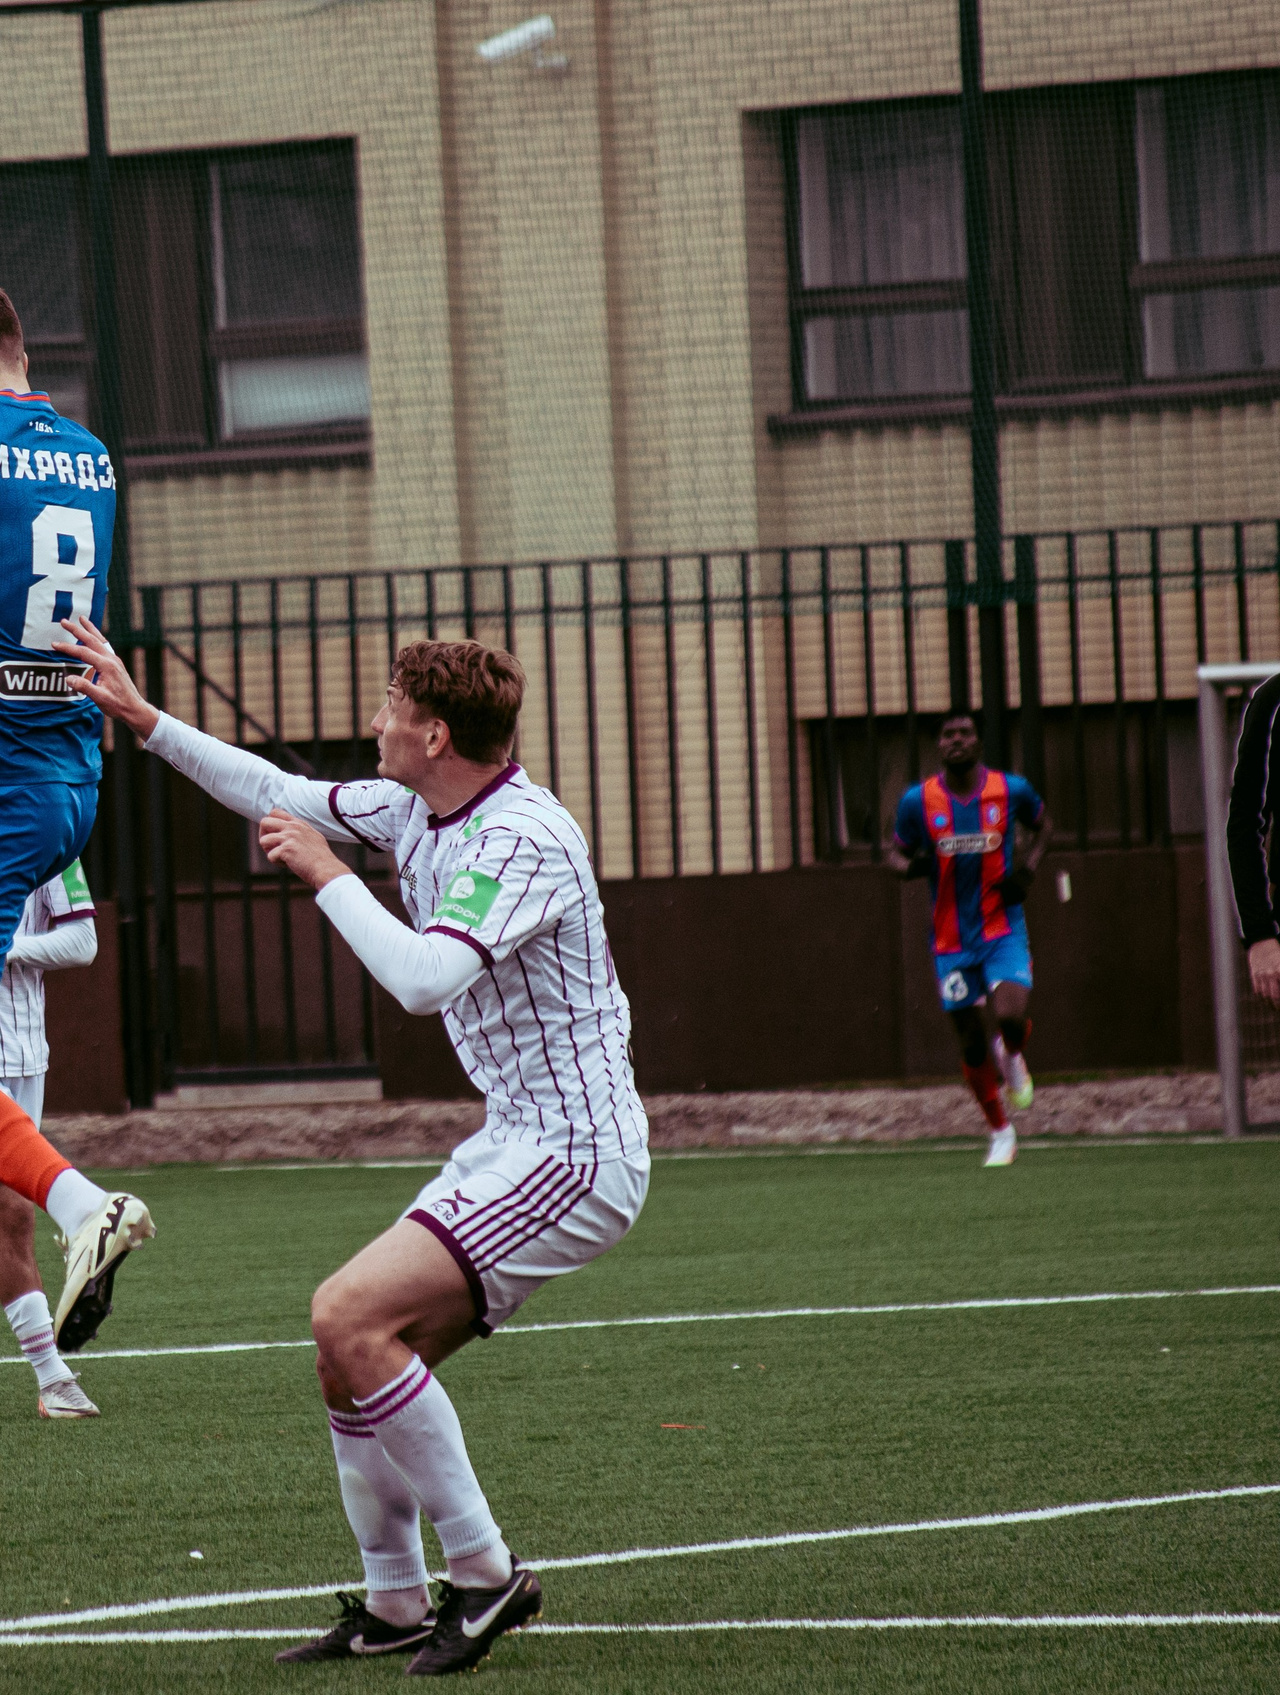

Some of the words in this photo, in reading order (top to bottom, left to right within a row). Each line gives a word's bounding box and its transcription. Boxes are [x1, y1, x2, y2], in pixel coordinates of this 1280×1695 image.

[21, 505, 95, 650] 8
[4, 670, 73, 692] Winli
[430, 1202, 444, 1212] FC
[442, 1209, 454, 1221] 10
